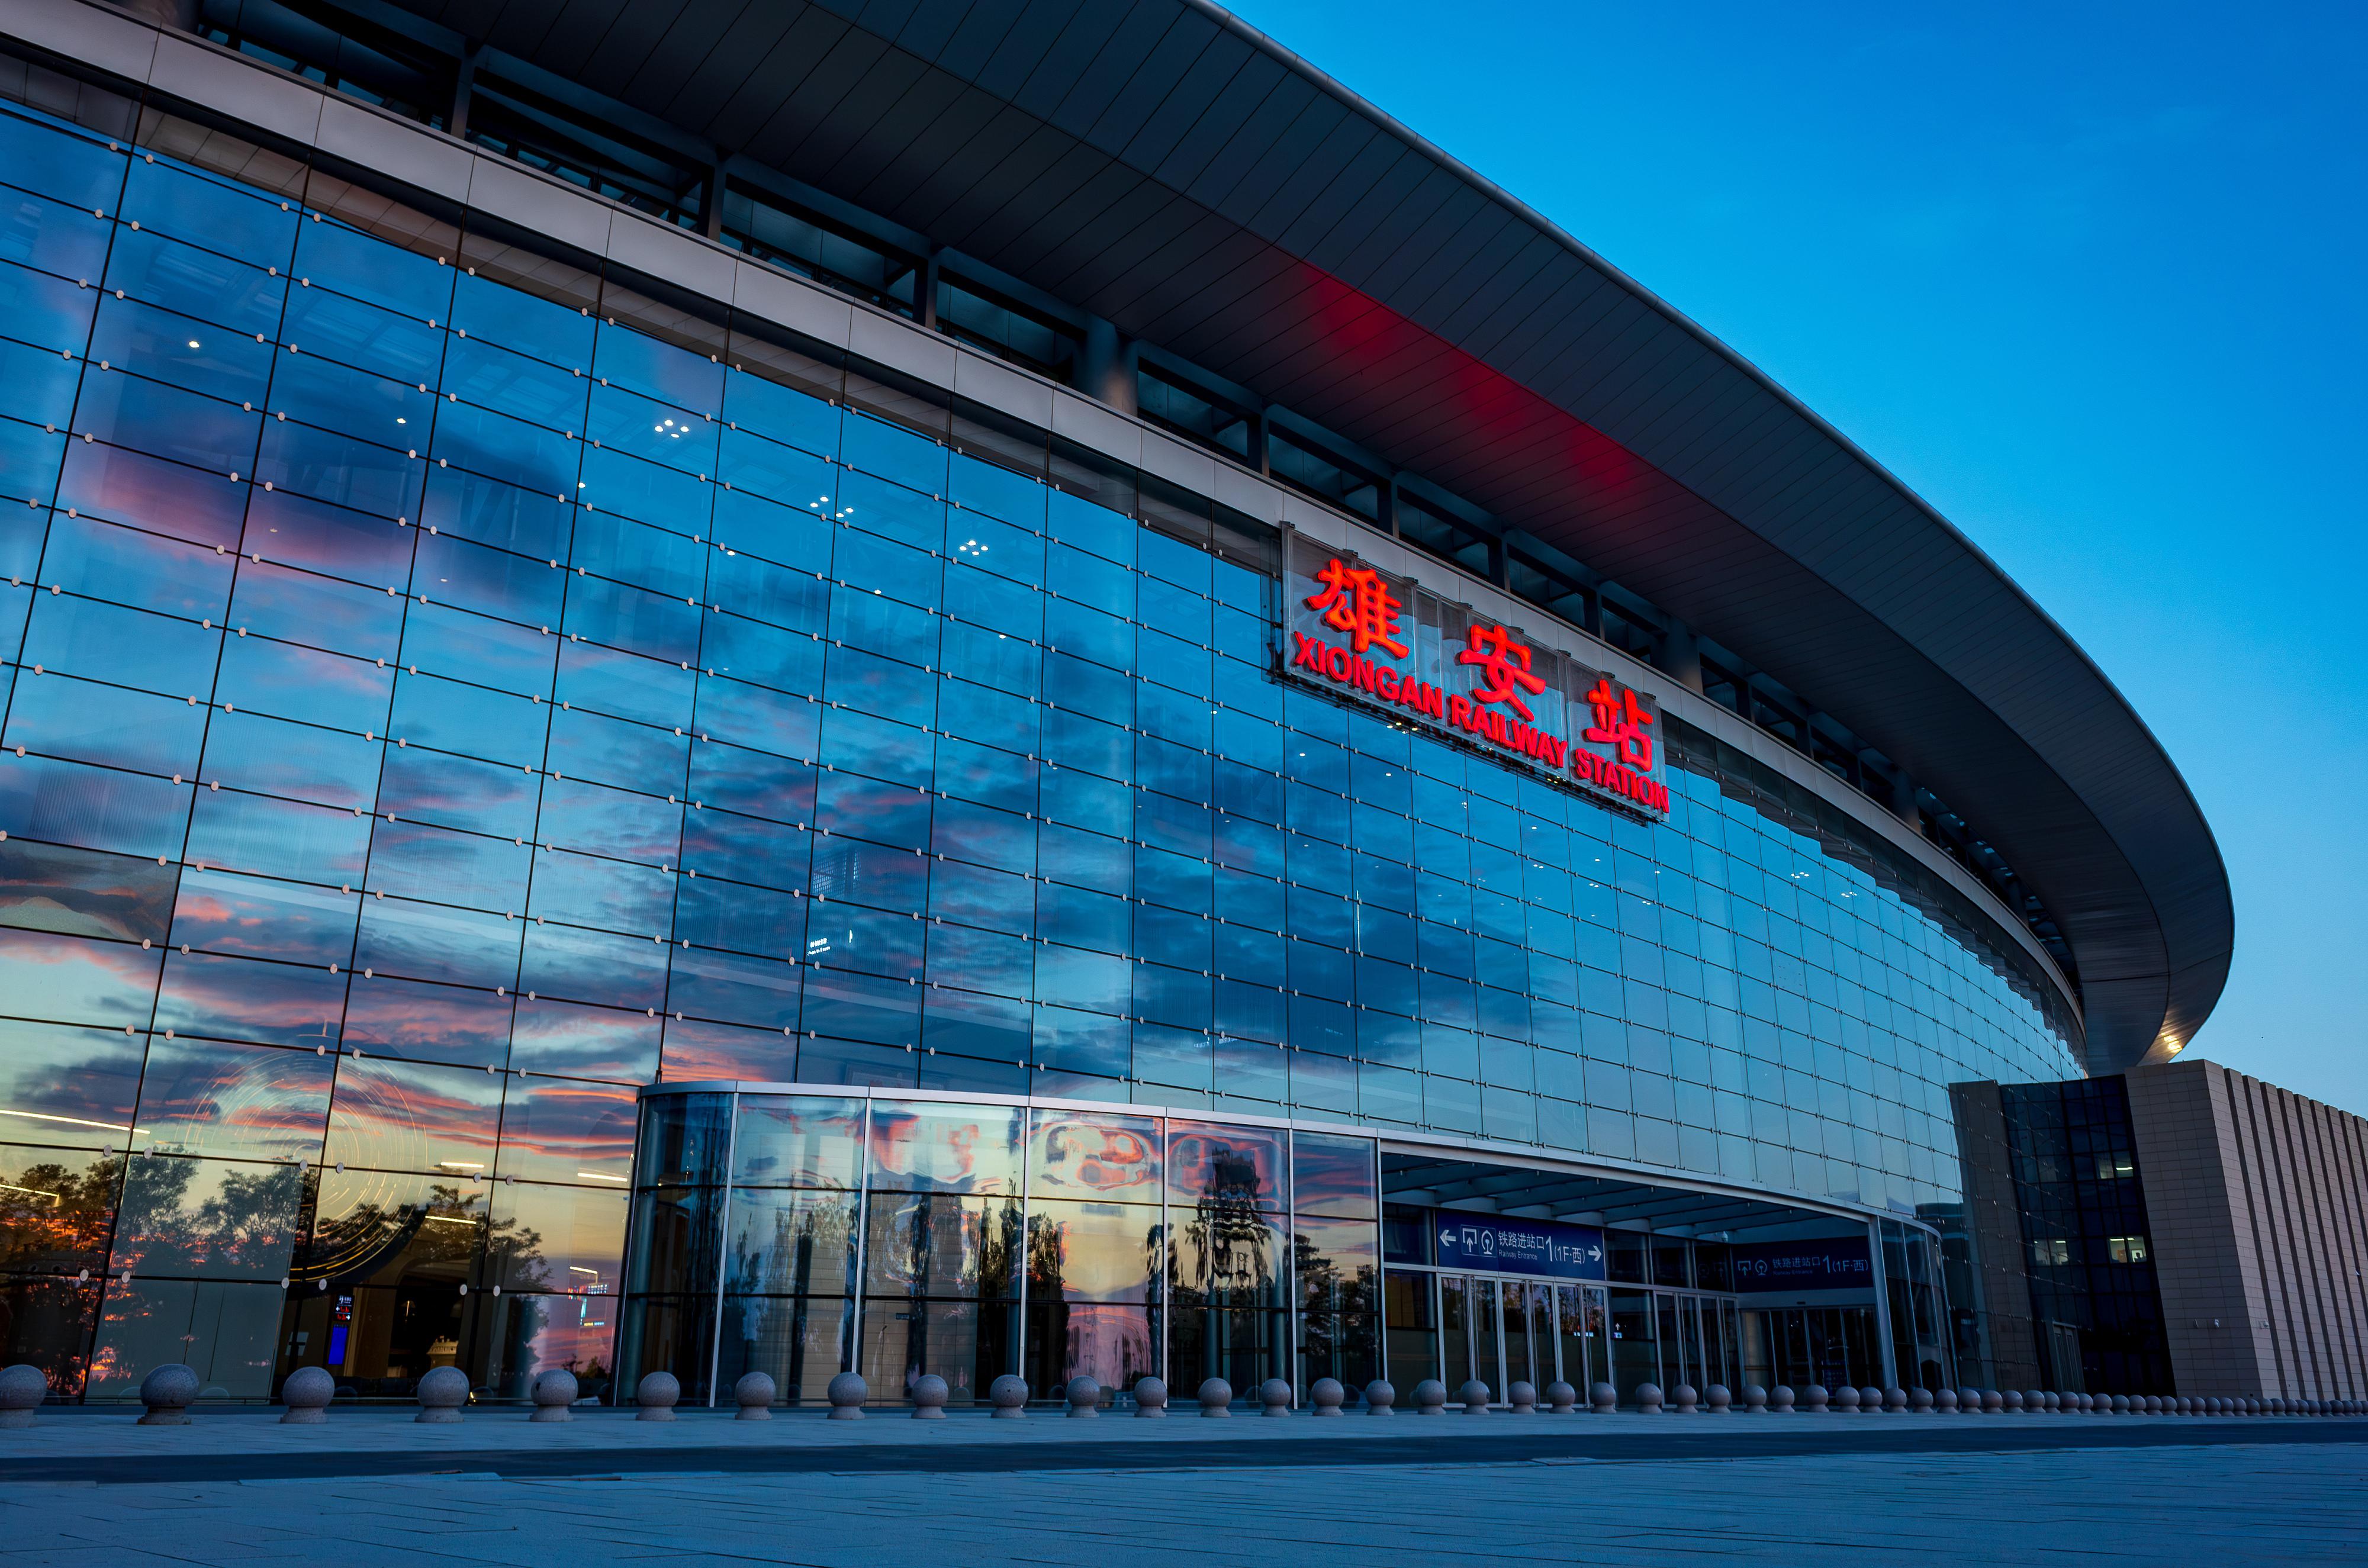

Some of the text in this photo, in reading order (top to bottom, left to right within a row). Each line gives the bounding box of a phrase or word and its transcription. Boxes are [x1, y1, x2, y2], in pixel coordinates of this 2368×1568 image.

[1294, 631, 1669, 813] XIONGAN RAILWAY STATION
[1307, 558, 1653, 772] 雄安站
[1498, 1250, 1537, 1260] Railway Entrance
